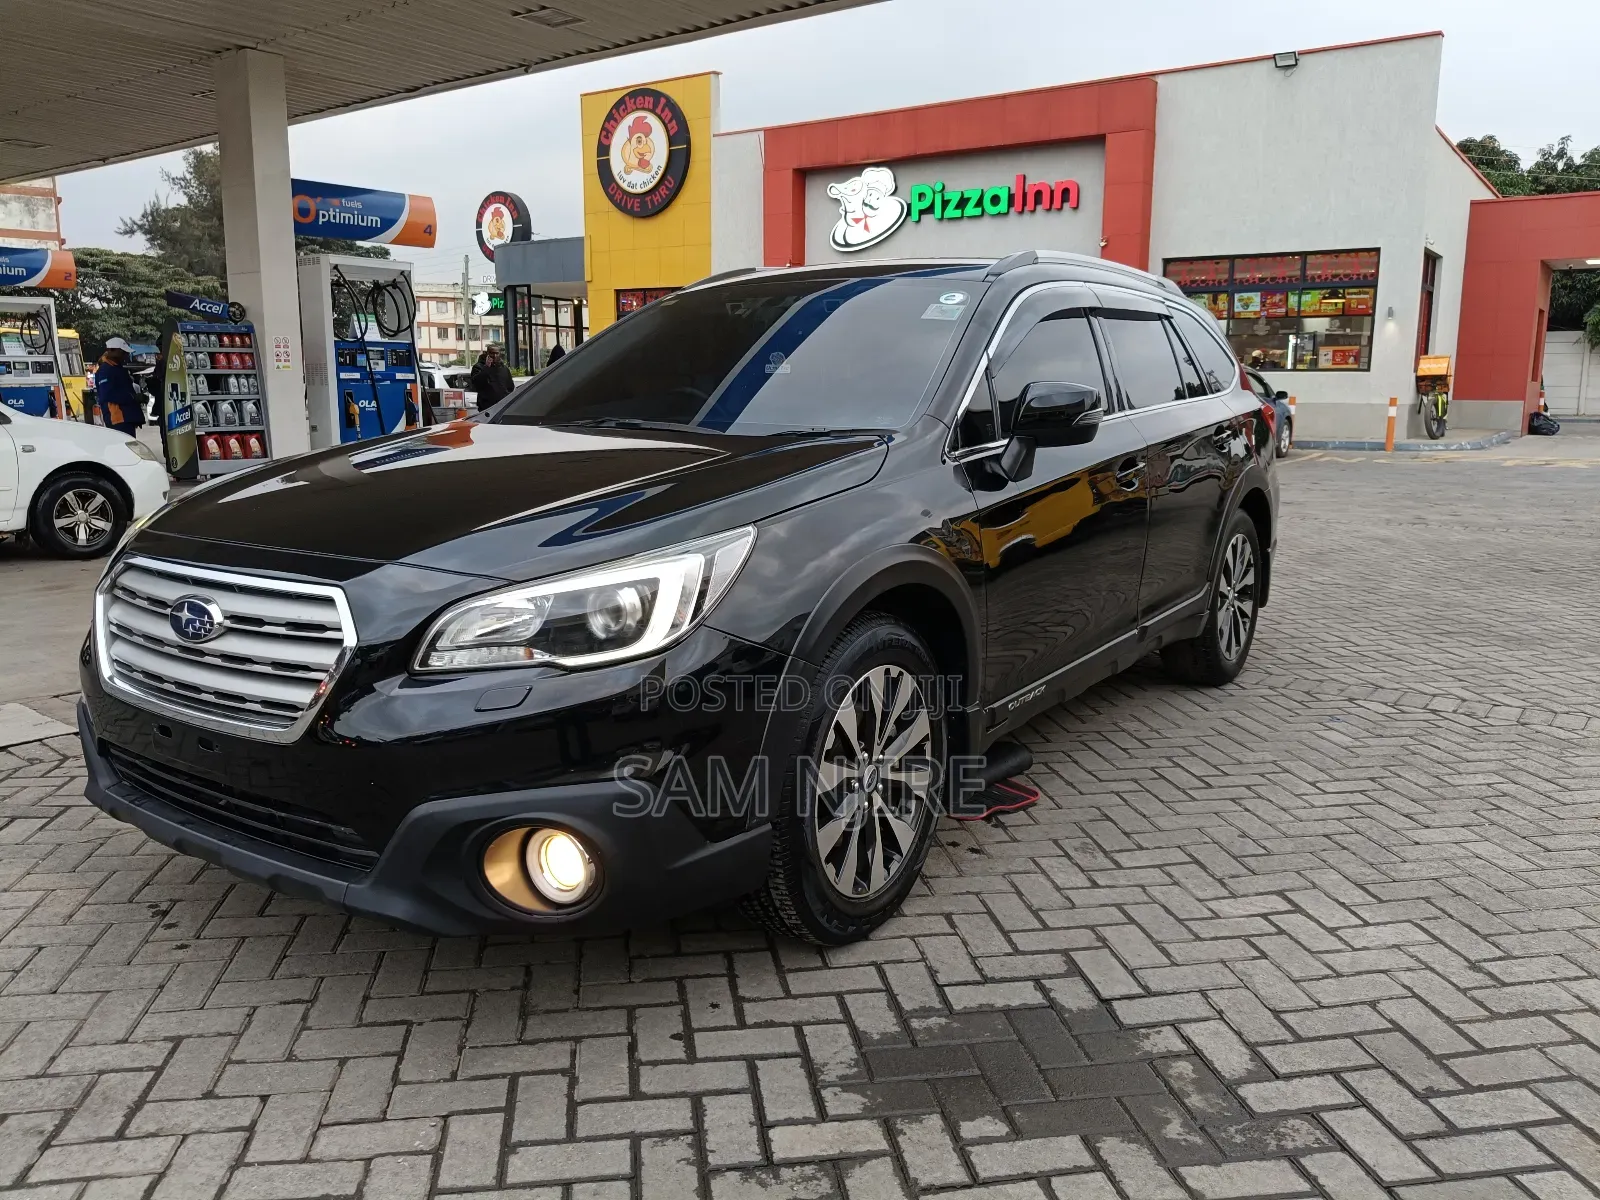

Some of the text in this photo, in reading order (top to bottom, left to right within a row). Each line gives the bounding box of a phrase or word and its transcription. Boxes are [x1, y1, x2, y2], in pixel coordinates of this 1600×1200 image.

[600, 95, 679, 146] Chicken Inn
[617, 165, 663, 190] luv dat chicken
[608, 175, 675, 212] DRIVE THRU
[341, 198, 363, 209] fuels
[423, 224, 433, 237] 4
[63, 271, 72, 281] 2
[190, 298, 224, 315] Accel
[359, 399, 378, 408] OLA
[175, 408, 191, 424] Accel
[1008, 684, 1047, 712] OUTBACK
